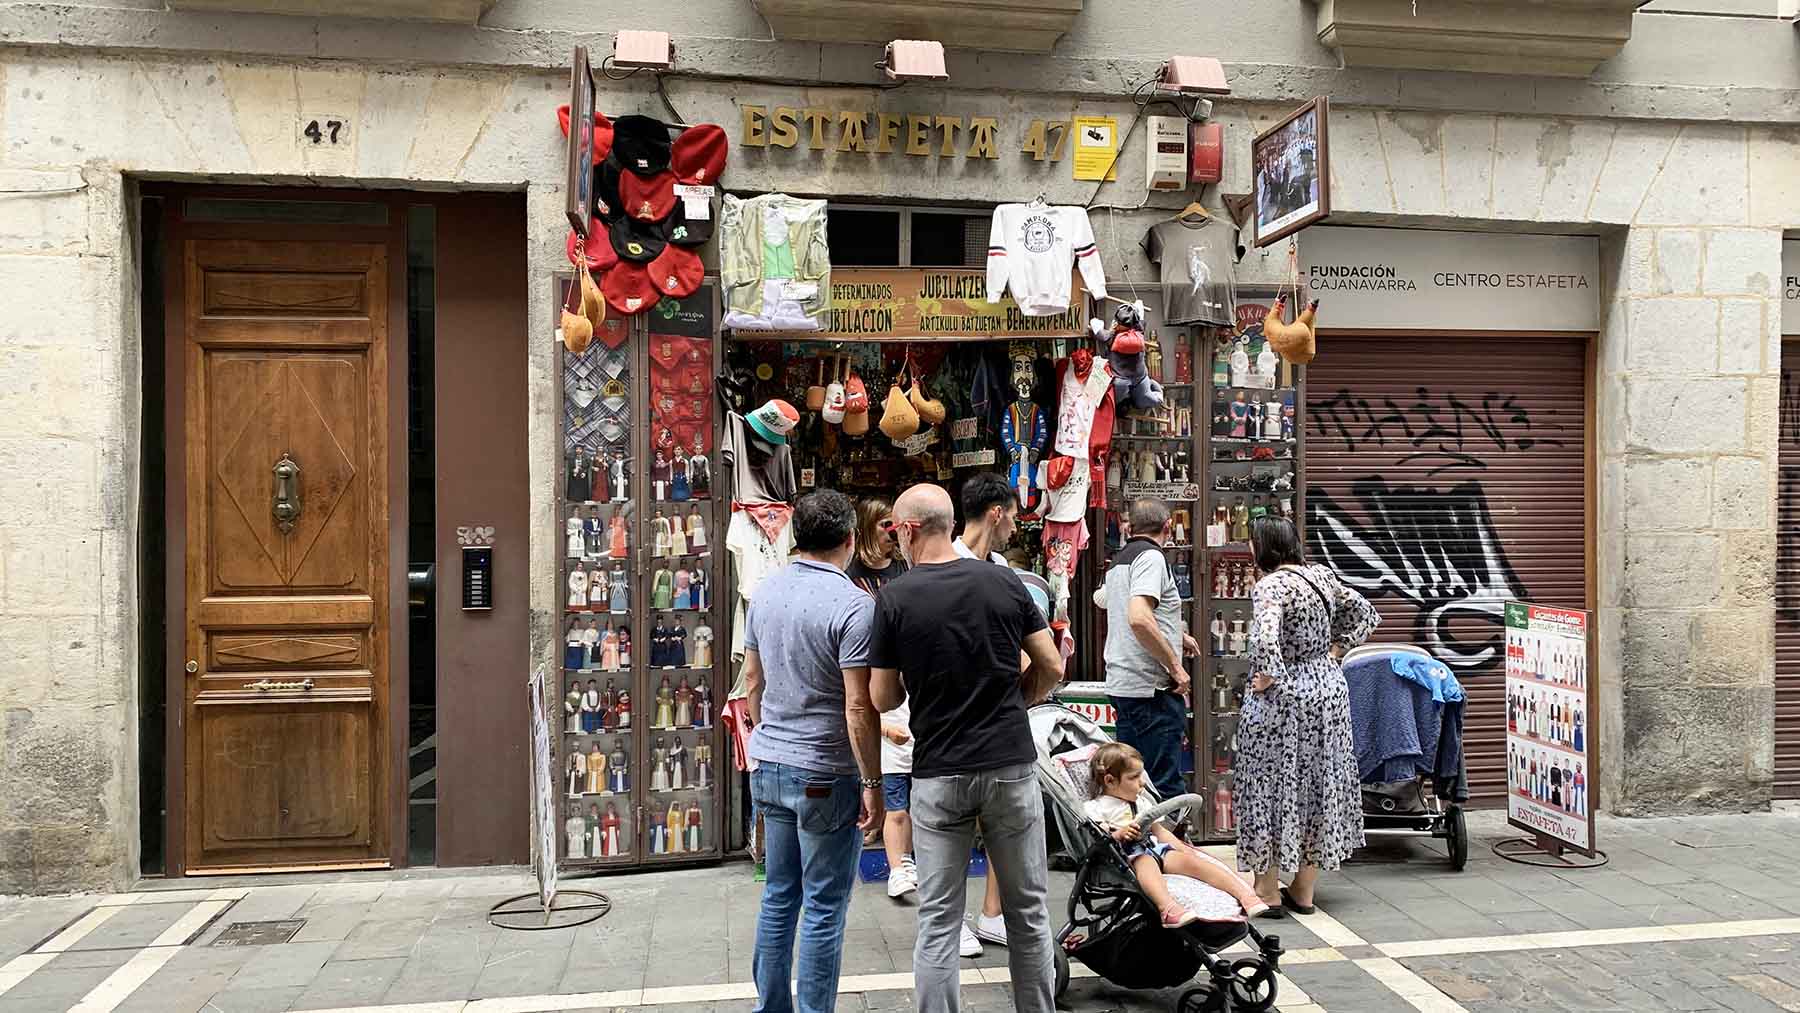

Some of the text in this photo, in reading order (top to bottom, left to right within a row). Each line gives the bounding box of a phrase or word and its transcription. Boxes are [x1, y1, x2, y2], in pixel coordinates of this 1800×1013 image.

[304, 119, 342, 144] 47
[740, 104, 1000, 160] ESTAFETA
[1020, 119, 1071, 162] 47
[1310, 264, 1396, 278] FUNDACIÓN
[919, 275, 988, 300] JUBILATZEN
[1309, 278, 1417, 292] CAJANAVARRA
[1433, 272, 1589, 289] CENTRO ESTAFETA
[833, 283, 893, 301] DETERMINADOS
[919, 316, 958, 332] ARTIKULU
[961, 316, 1000, 332] BATZUETAN
[1517, 806, 1565, 837] ESTAFETA
[1564, 826, 1577, 841] 47
